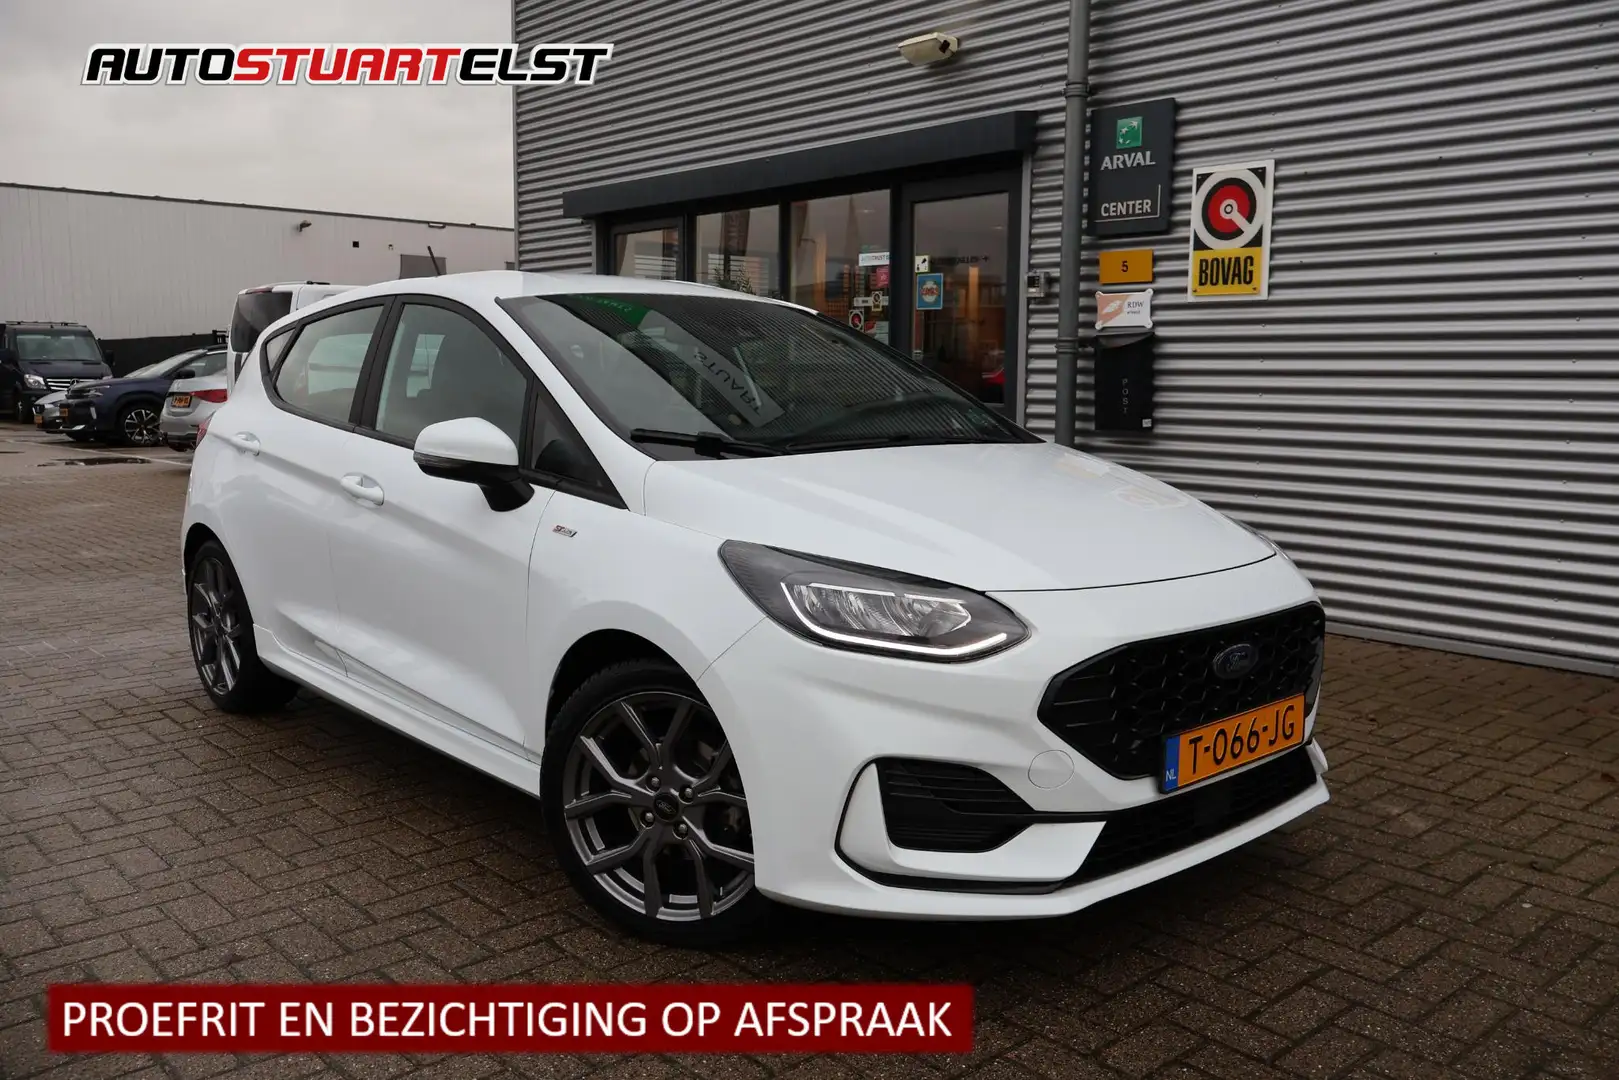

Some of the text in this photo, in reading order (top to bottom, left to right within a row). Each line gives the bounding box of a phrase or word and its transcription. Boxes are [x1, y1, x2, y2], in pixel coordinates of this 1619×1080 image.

[1100, 150, 1156, 171] ARVAL
[1100, 199, 1152, 217] CENTER
[1121, 260, 1129, 273] 5
[1198, 255, 1254, 287] BOVAG
[1127, 300, 1144, 309] RDW
[1188, 704, 1295, 775] T-066-JG
[1165, 768, 1177, 782] NL
